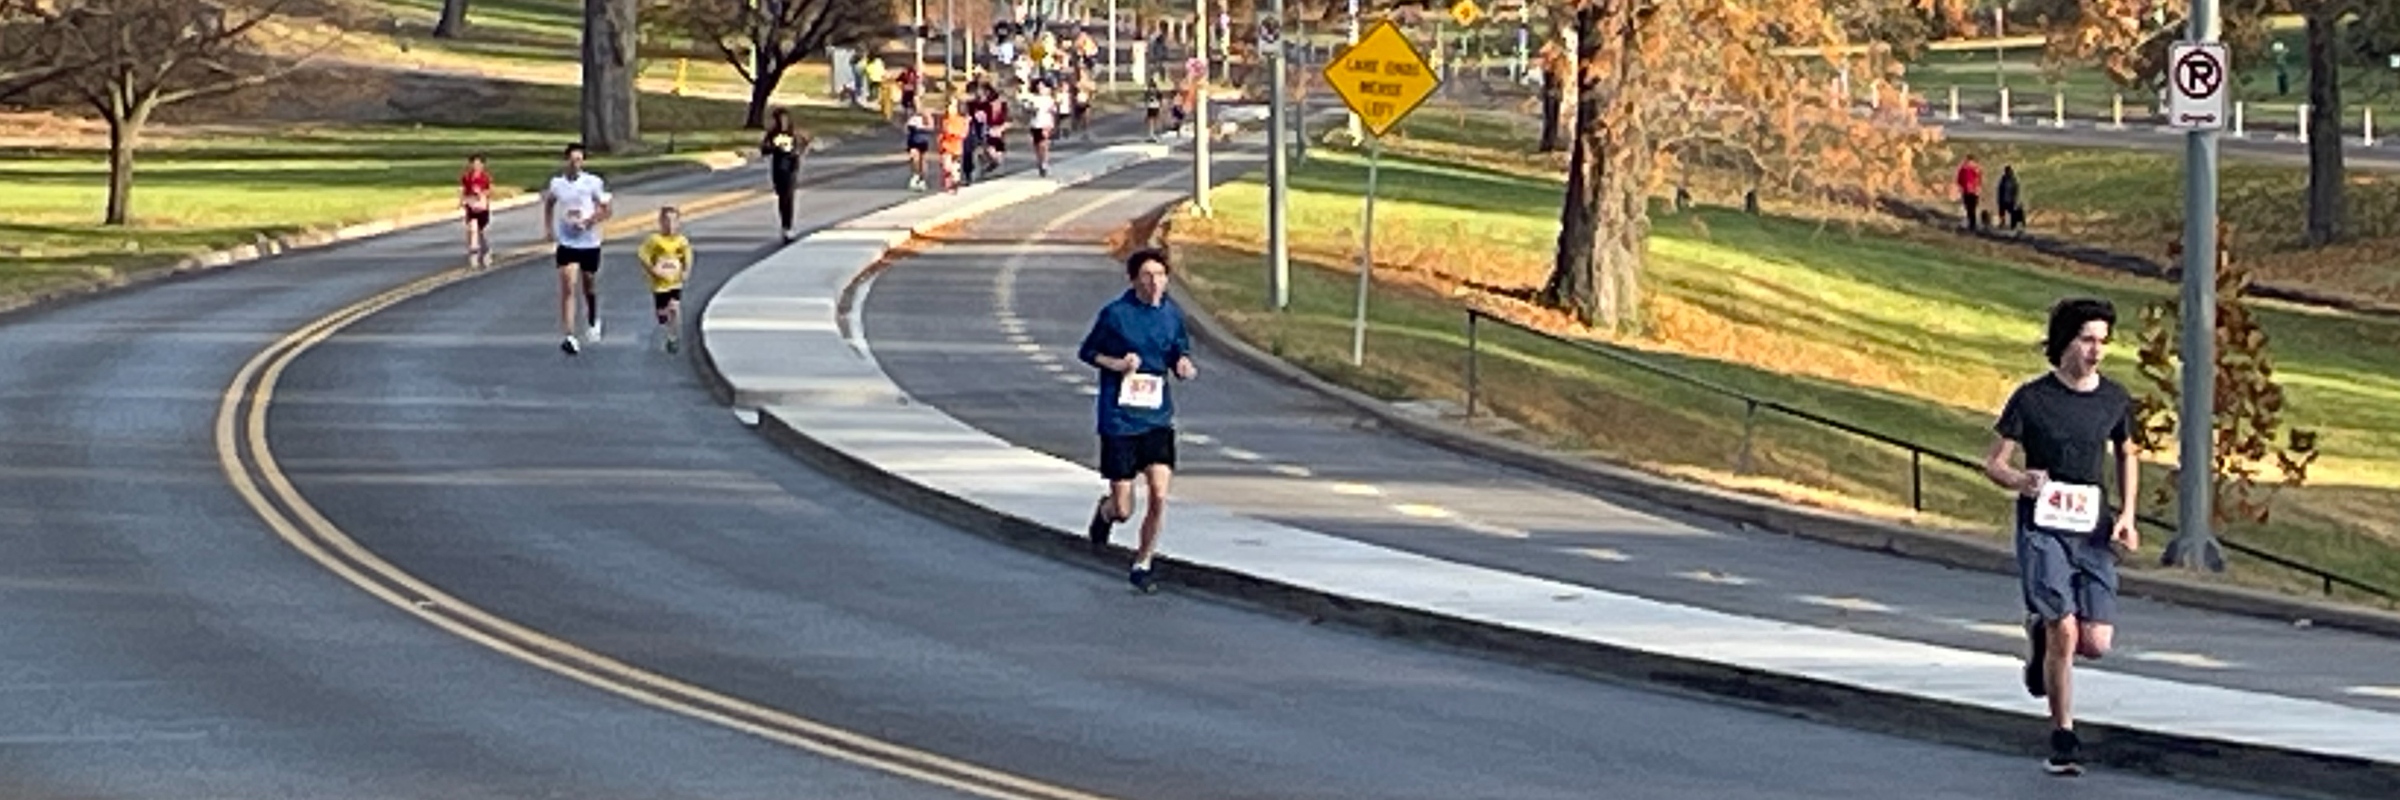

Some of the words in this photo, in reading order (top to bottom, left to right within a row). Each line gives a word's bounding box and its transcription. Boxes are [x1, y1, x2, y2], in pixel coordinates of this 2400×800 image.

[1345, 58, 1379, 73] LANE
[1384, 61, 1421, 76] ENDS
[1359, 81, 1403, 96] MERGE
[2048, 490, 2088, 514] 412
